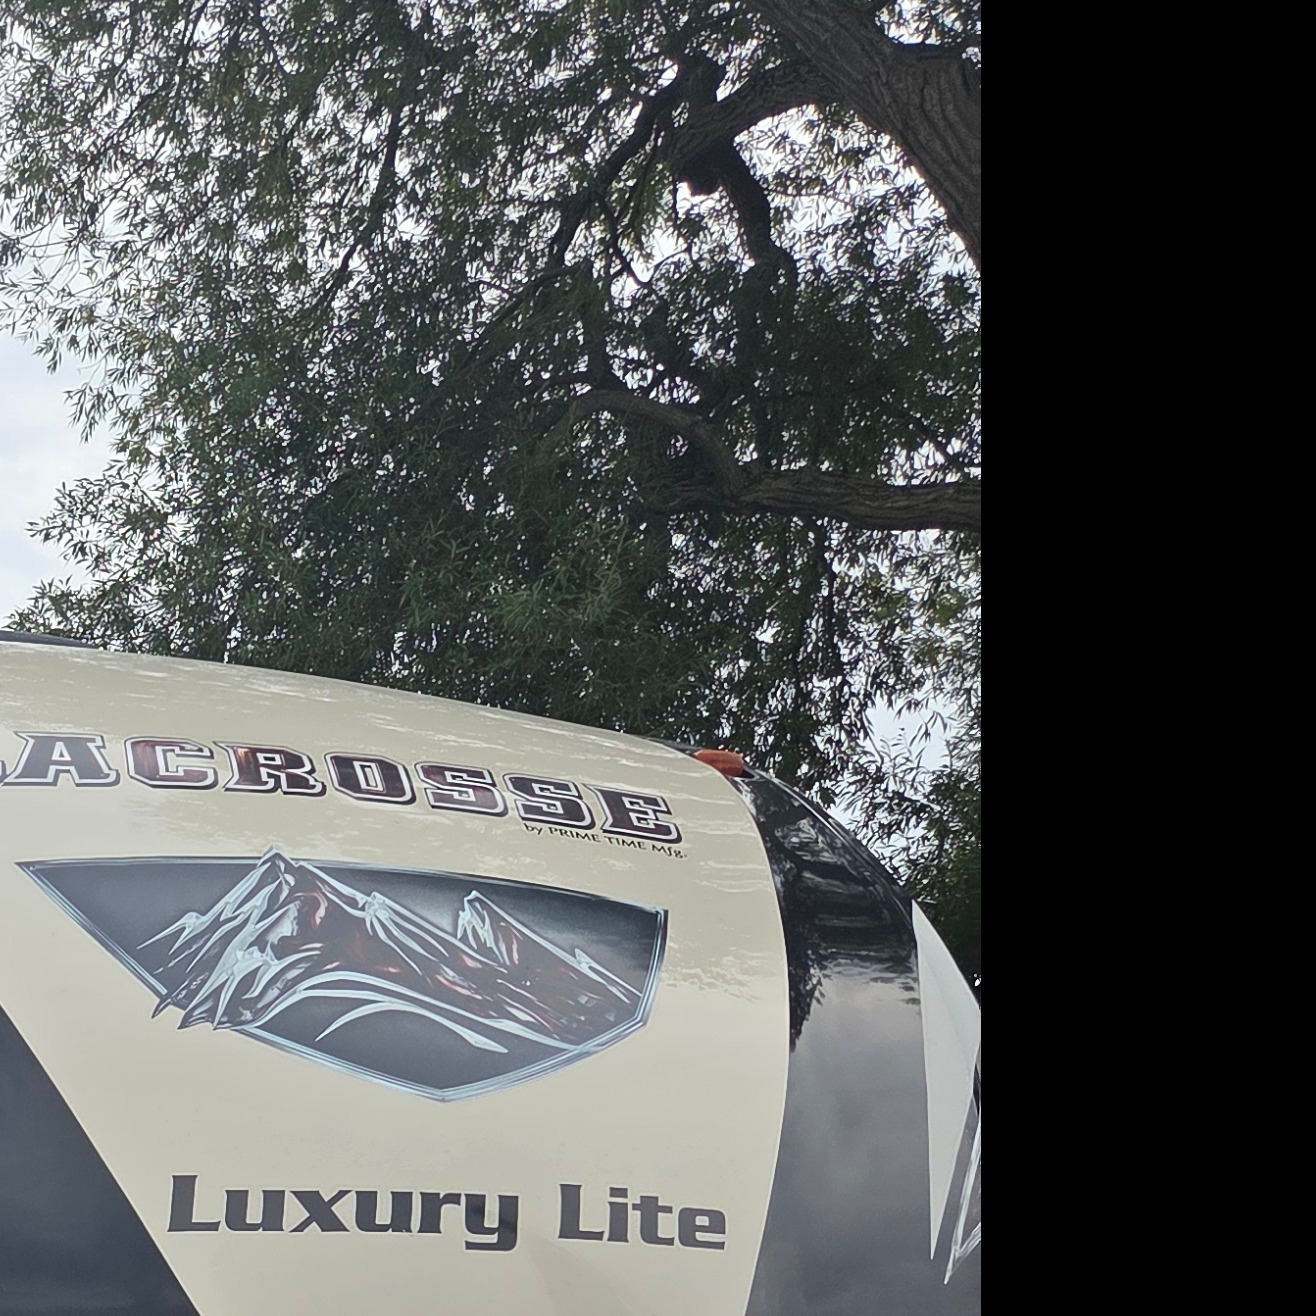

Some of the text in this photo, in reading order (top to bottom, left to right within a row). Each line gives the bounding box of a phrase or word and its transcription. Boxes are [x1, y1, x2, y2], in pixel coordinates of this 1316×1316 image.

[523, 823, 543, 836] by
[549, 827, 602, 843] PRIME
[604, 835, 647, 850] TIME
[167, 1174, 727, 1251] Luxury Lite
